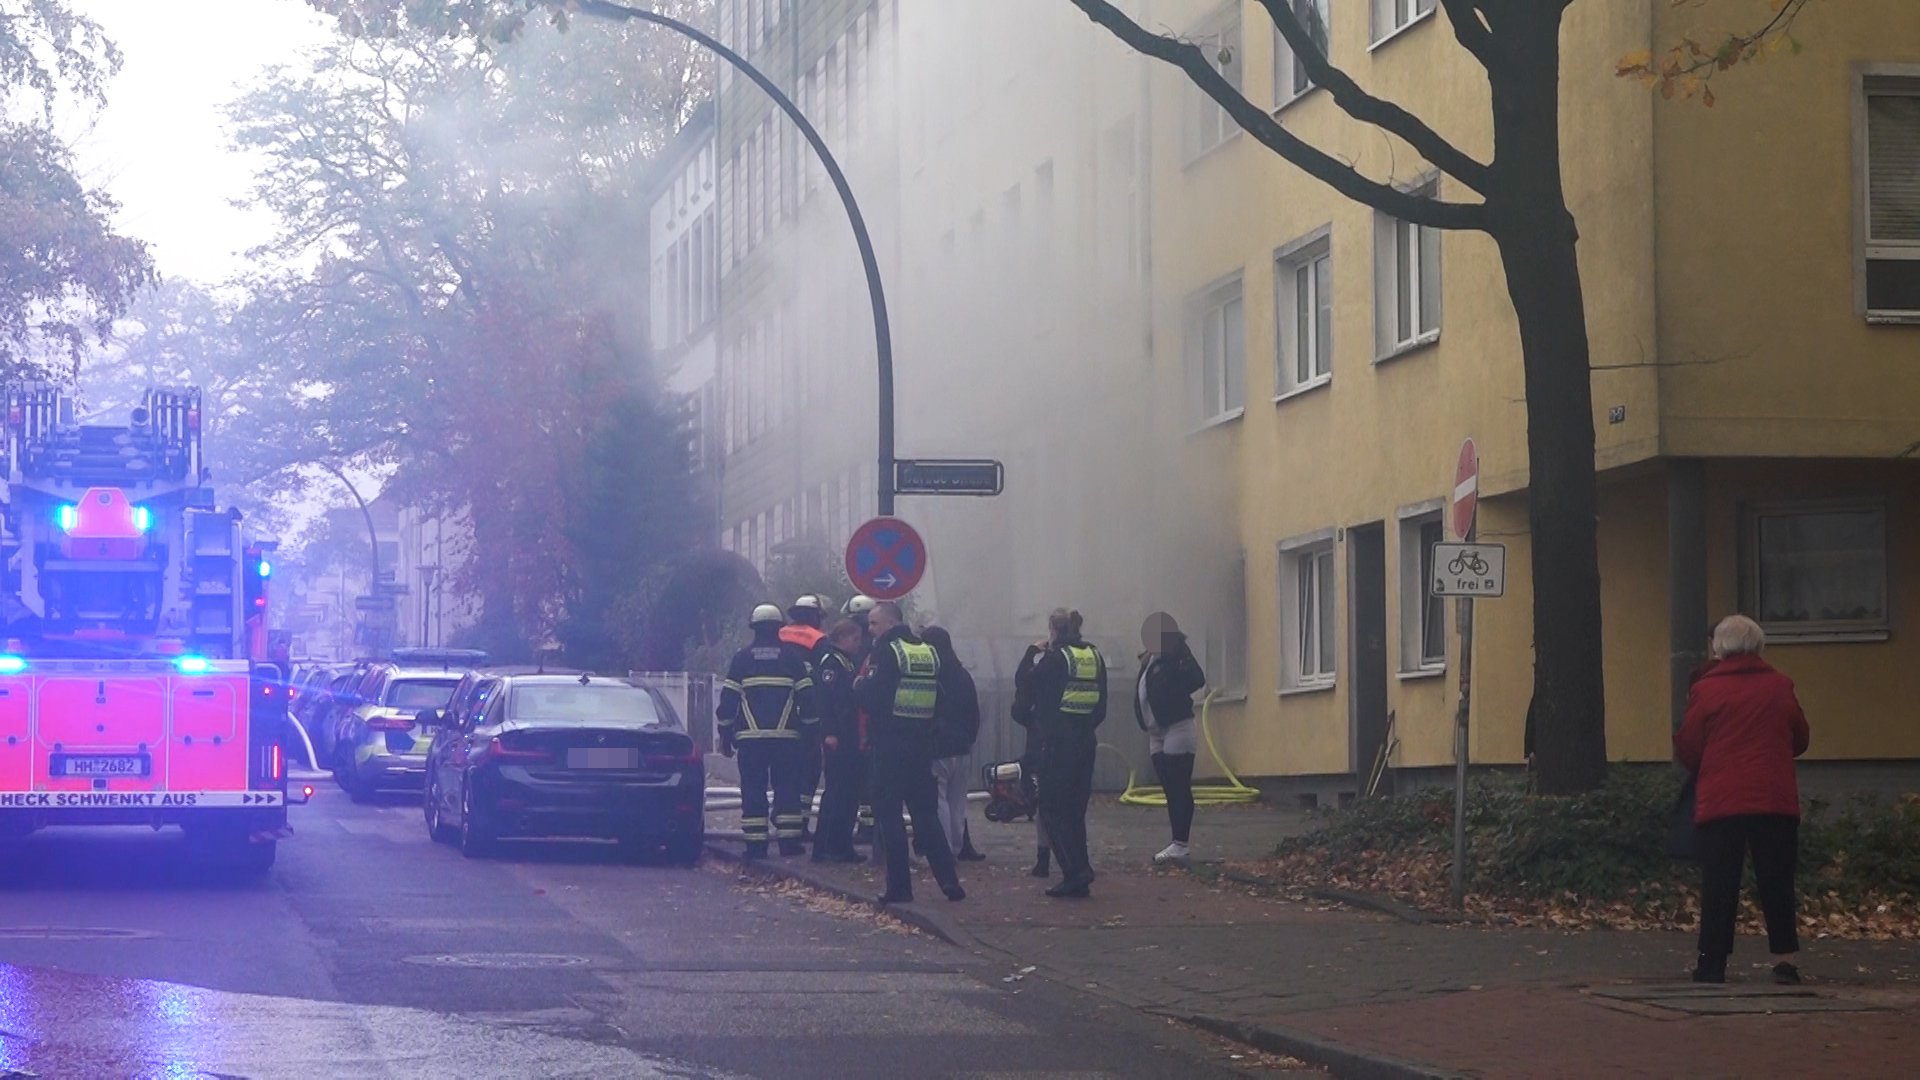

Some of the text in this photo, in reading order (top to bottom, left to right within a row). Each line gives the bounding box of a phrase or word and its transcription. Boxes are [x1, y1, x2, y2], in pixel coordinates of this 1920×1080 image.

[1457, 577, 1479, 590] frei
[74, 759, 134, 772] HH 2682
[1, 793, 197, 806] HECK SCHWENKT AUS
